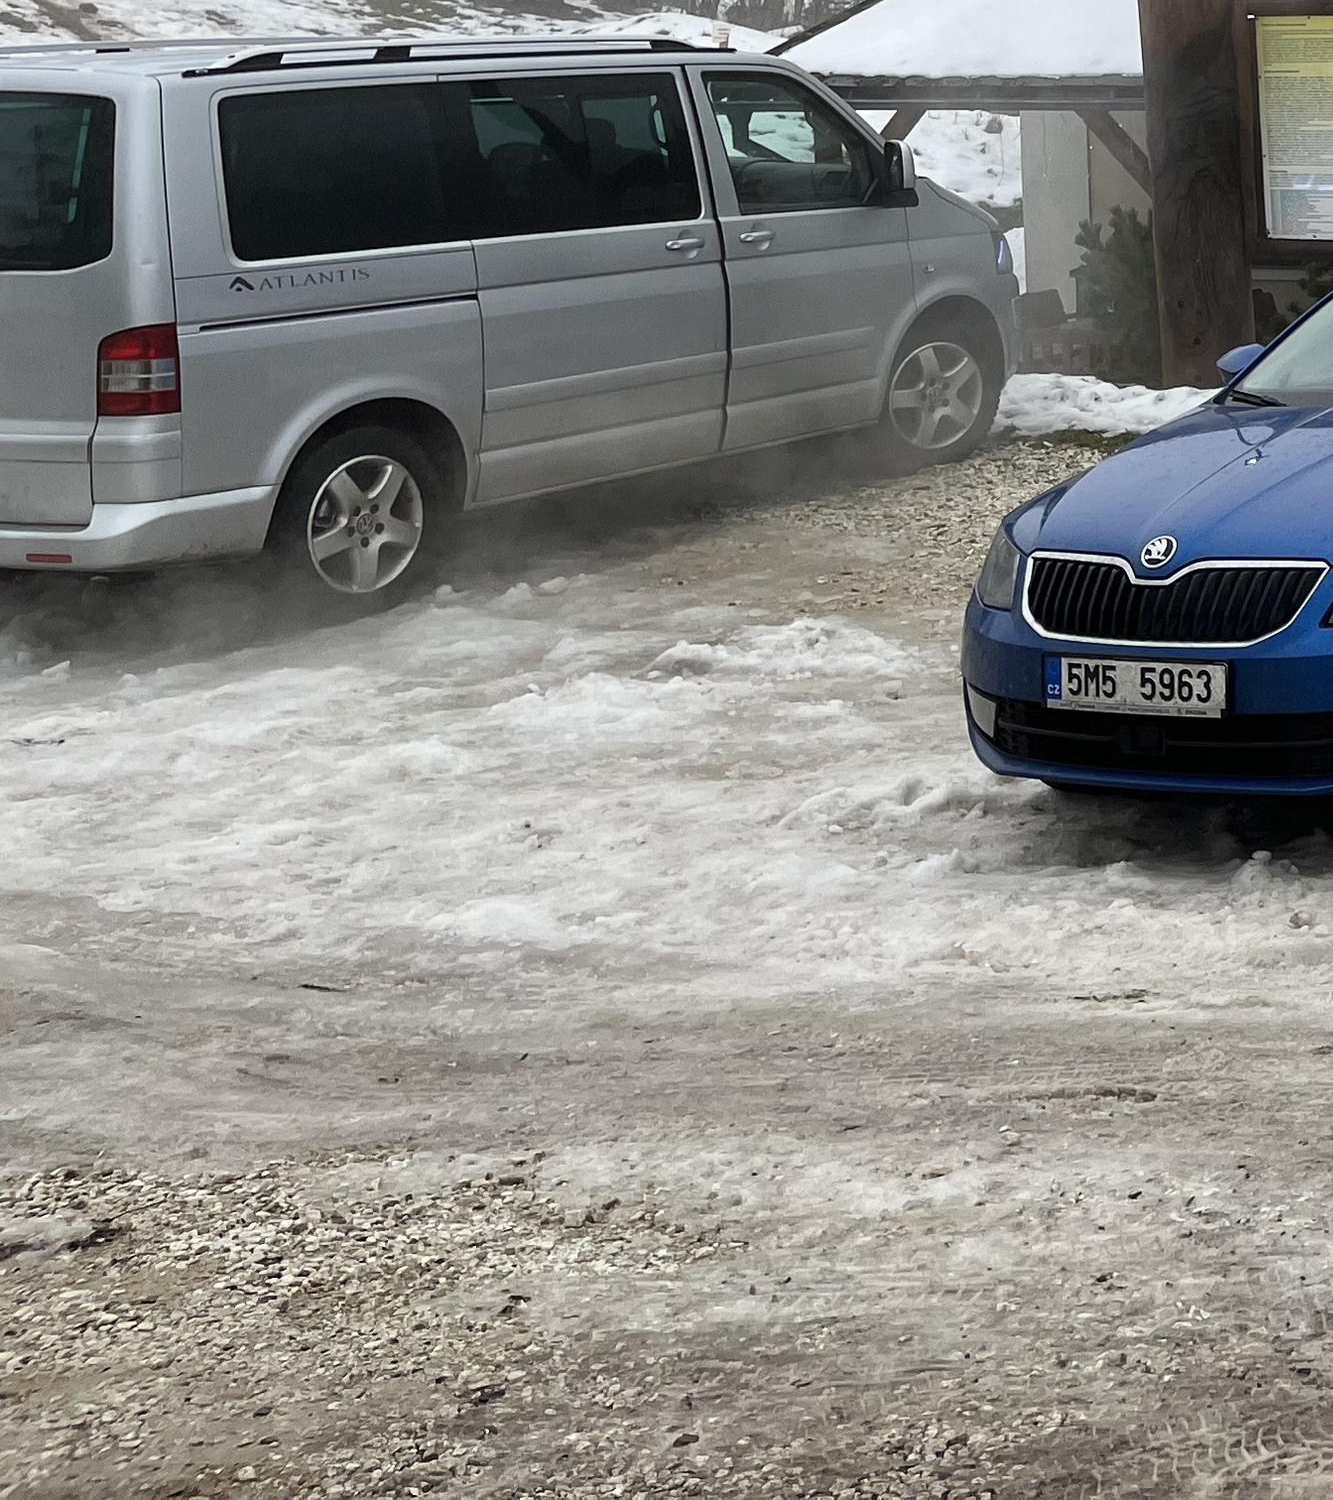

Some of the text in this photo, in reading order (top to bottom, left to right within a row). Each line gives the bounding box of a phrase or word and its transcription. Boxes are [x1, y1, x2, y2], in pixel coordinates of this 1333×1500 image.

[260, 268, 370, 291] ATLANTIS
[1047, 684, 1060, 695] CZ
[1067, 662, 1212, 703] 5M5 5963
